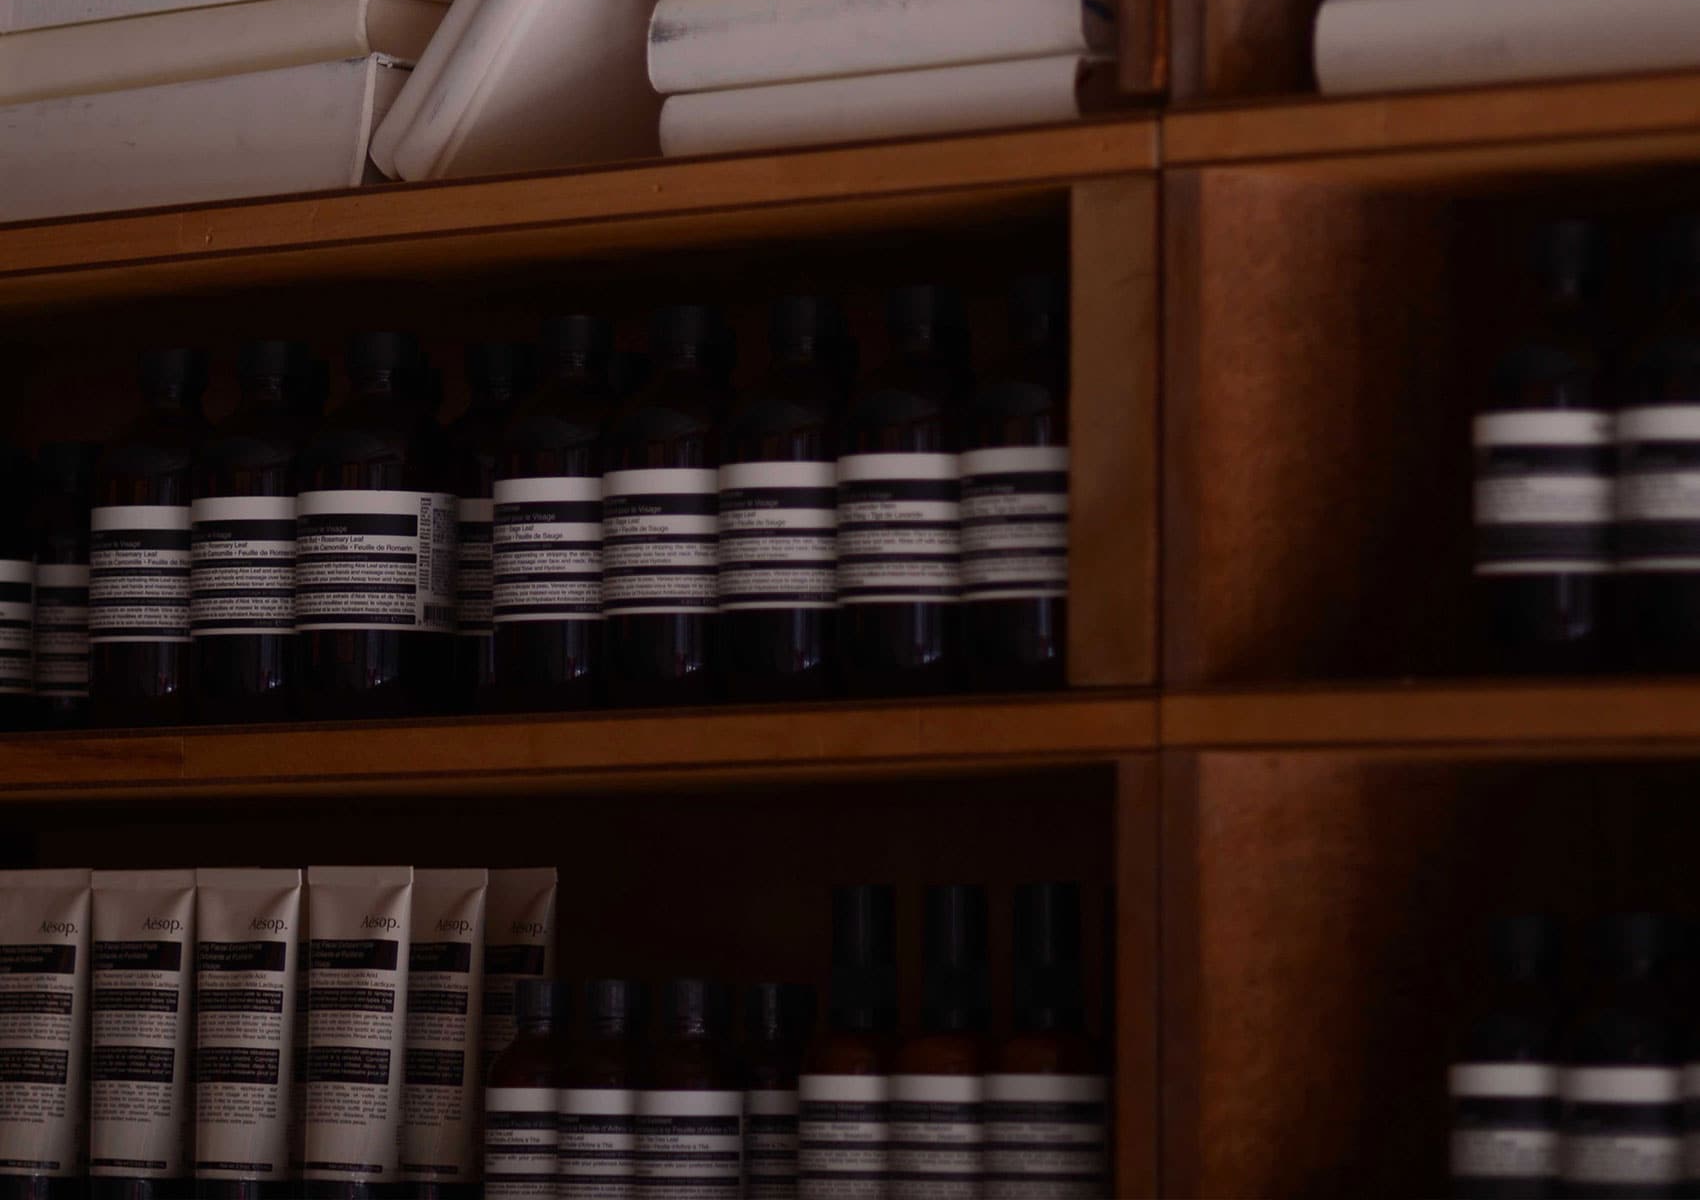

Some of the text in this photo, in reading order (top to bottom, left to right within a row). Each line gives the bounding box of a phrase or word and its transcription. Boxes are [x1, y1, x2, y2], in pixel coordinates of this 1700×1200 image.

[531, 511, 556, 522] Visage
[320, 535, 349, 544] Rosemary
[350, 535, 365, 543] Leaf
[543, 532, 564, 542] Sauge
[353, 544, 375, 552] Feuille
[375, 544, 385, 552] de
[386, 544, 413, 552] Romarin
[238, 550, 256, 558] Feuille
